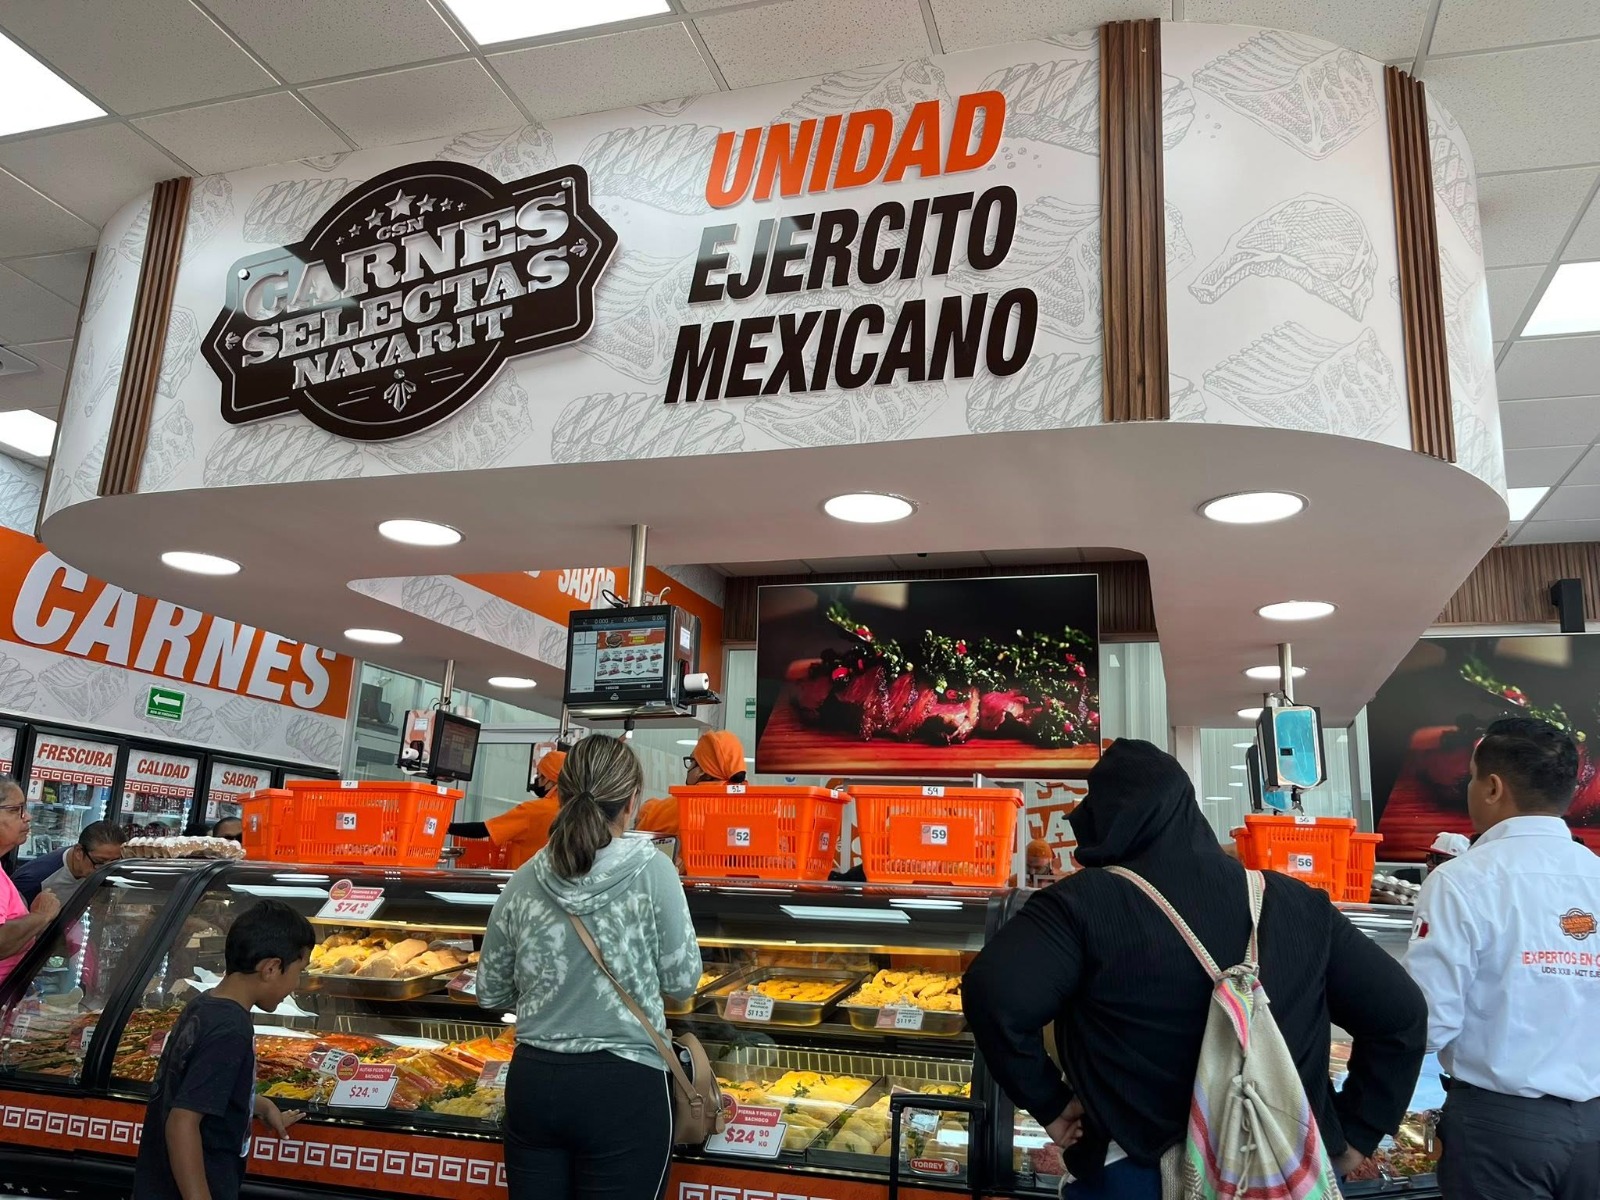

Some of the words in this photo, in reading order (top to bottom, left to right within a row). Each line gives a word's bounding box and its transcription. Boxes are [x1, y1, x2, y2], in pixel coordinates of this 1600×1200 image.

[705, 90, 1006, 209] UNIDAD
[376, 216, 425, 241] CSN
[688, 185, 1018, 305] EJERCITO
[242, 193, 570, 322] CARNES
[241, 246, 571, 368] SELECTAS
[292, 304, 513, 390] NAYARIT
[664, 287, 1039, 405] MEXICANO
[12, 551, 337, 709] CARNES
[37, 743, 113, 768] FRESCURA
[137, 759, 190, 779] CALIDAD
[222, 771, 258, 789] SABOR
[30, 787, 36, 795] 4
[343, 816, 355, 825] 51
[428, 821, 436, 830] 51
[736, 832, 749, 841] 52
[931, 829, 947, 839] 59
[1298, 858, 1312, 867] 56
[334, 901, 359, 913] $74
[1580, 953, 1593, 966] EN
[725, 1126, 755, 1144] $24
[758, 1130, 770, 1138] 90
[913, 1160, 944, 1170] TORREY
